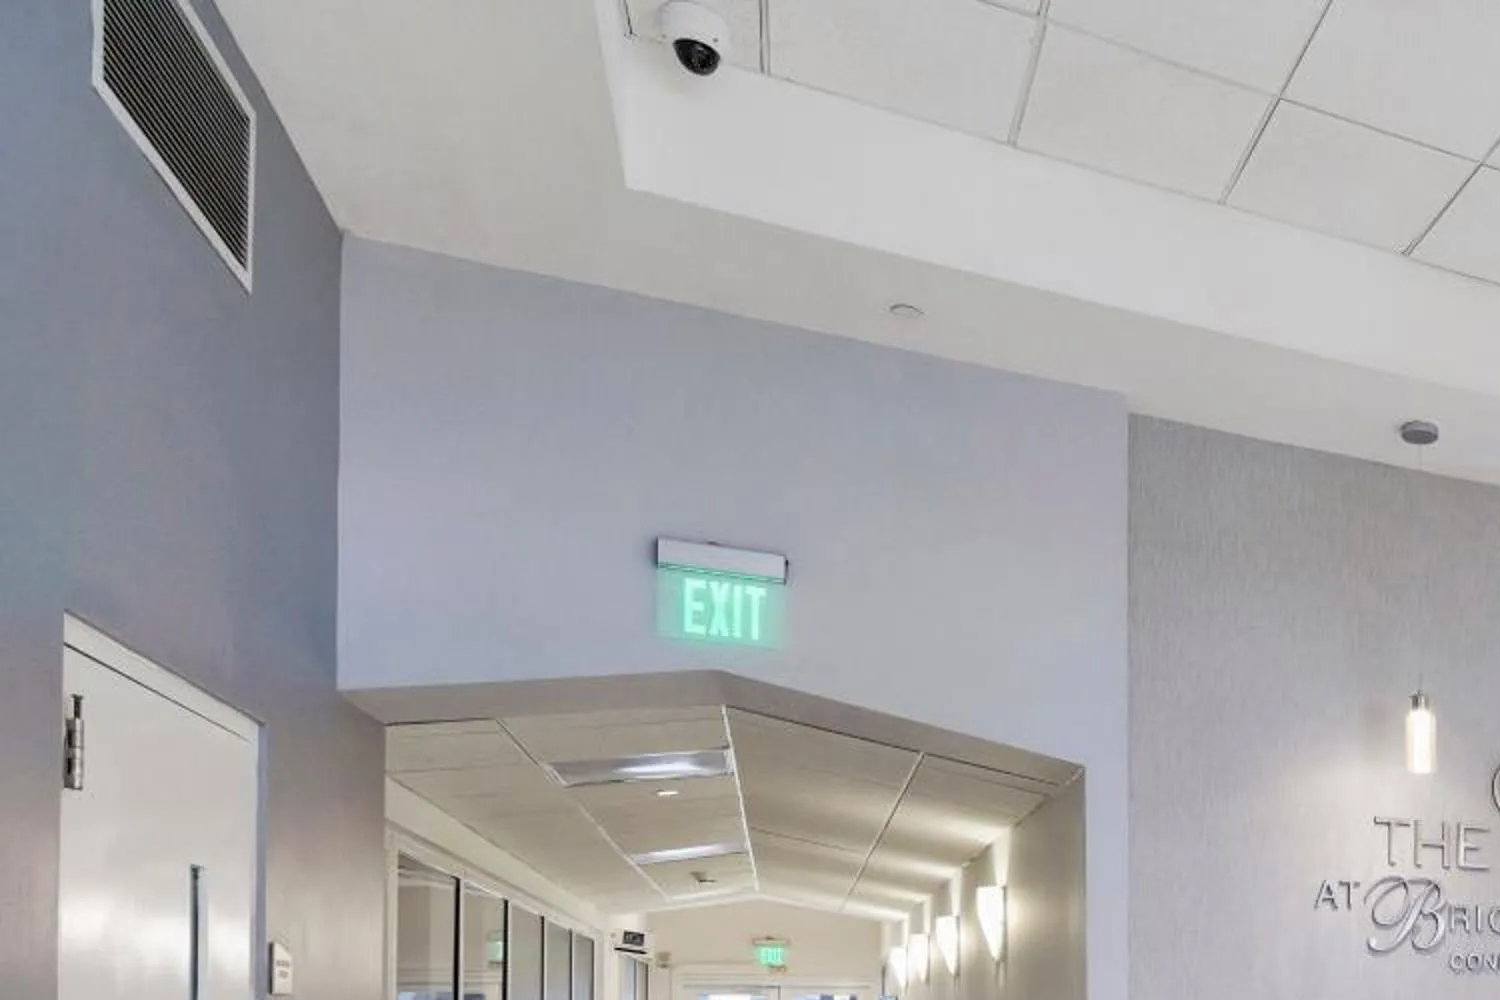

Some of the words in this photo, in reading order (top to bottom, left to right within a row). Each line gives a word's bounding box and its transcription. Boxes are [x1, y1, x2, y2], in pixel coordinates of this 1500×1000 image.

[683, 578, 767, 641] EXIT
[1373, 816, 1490, 871] THE
[1314, 879, 1361, 911] AT
